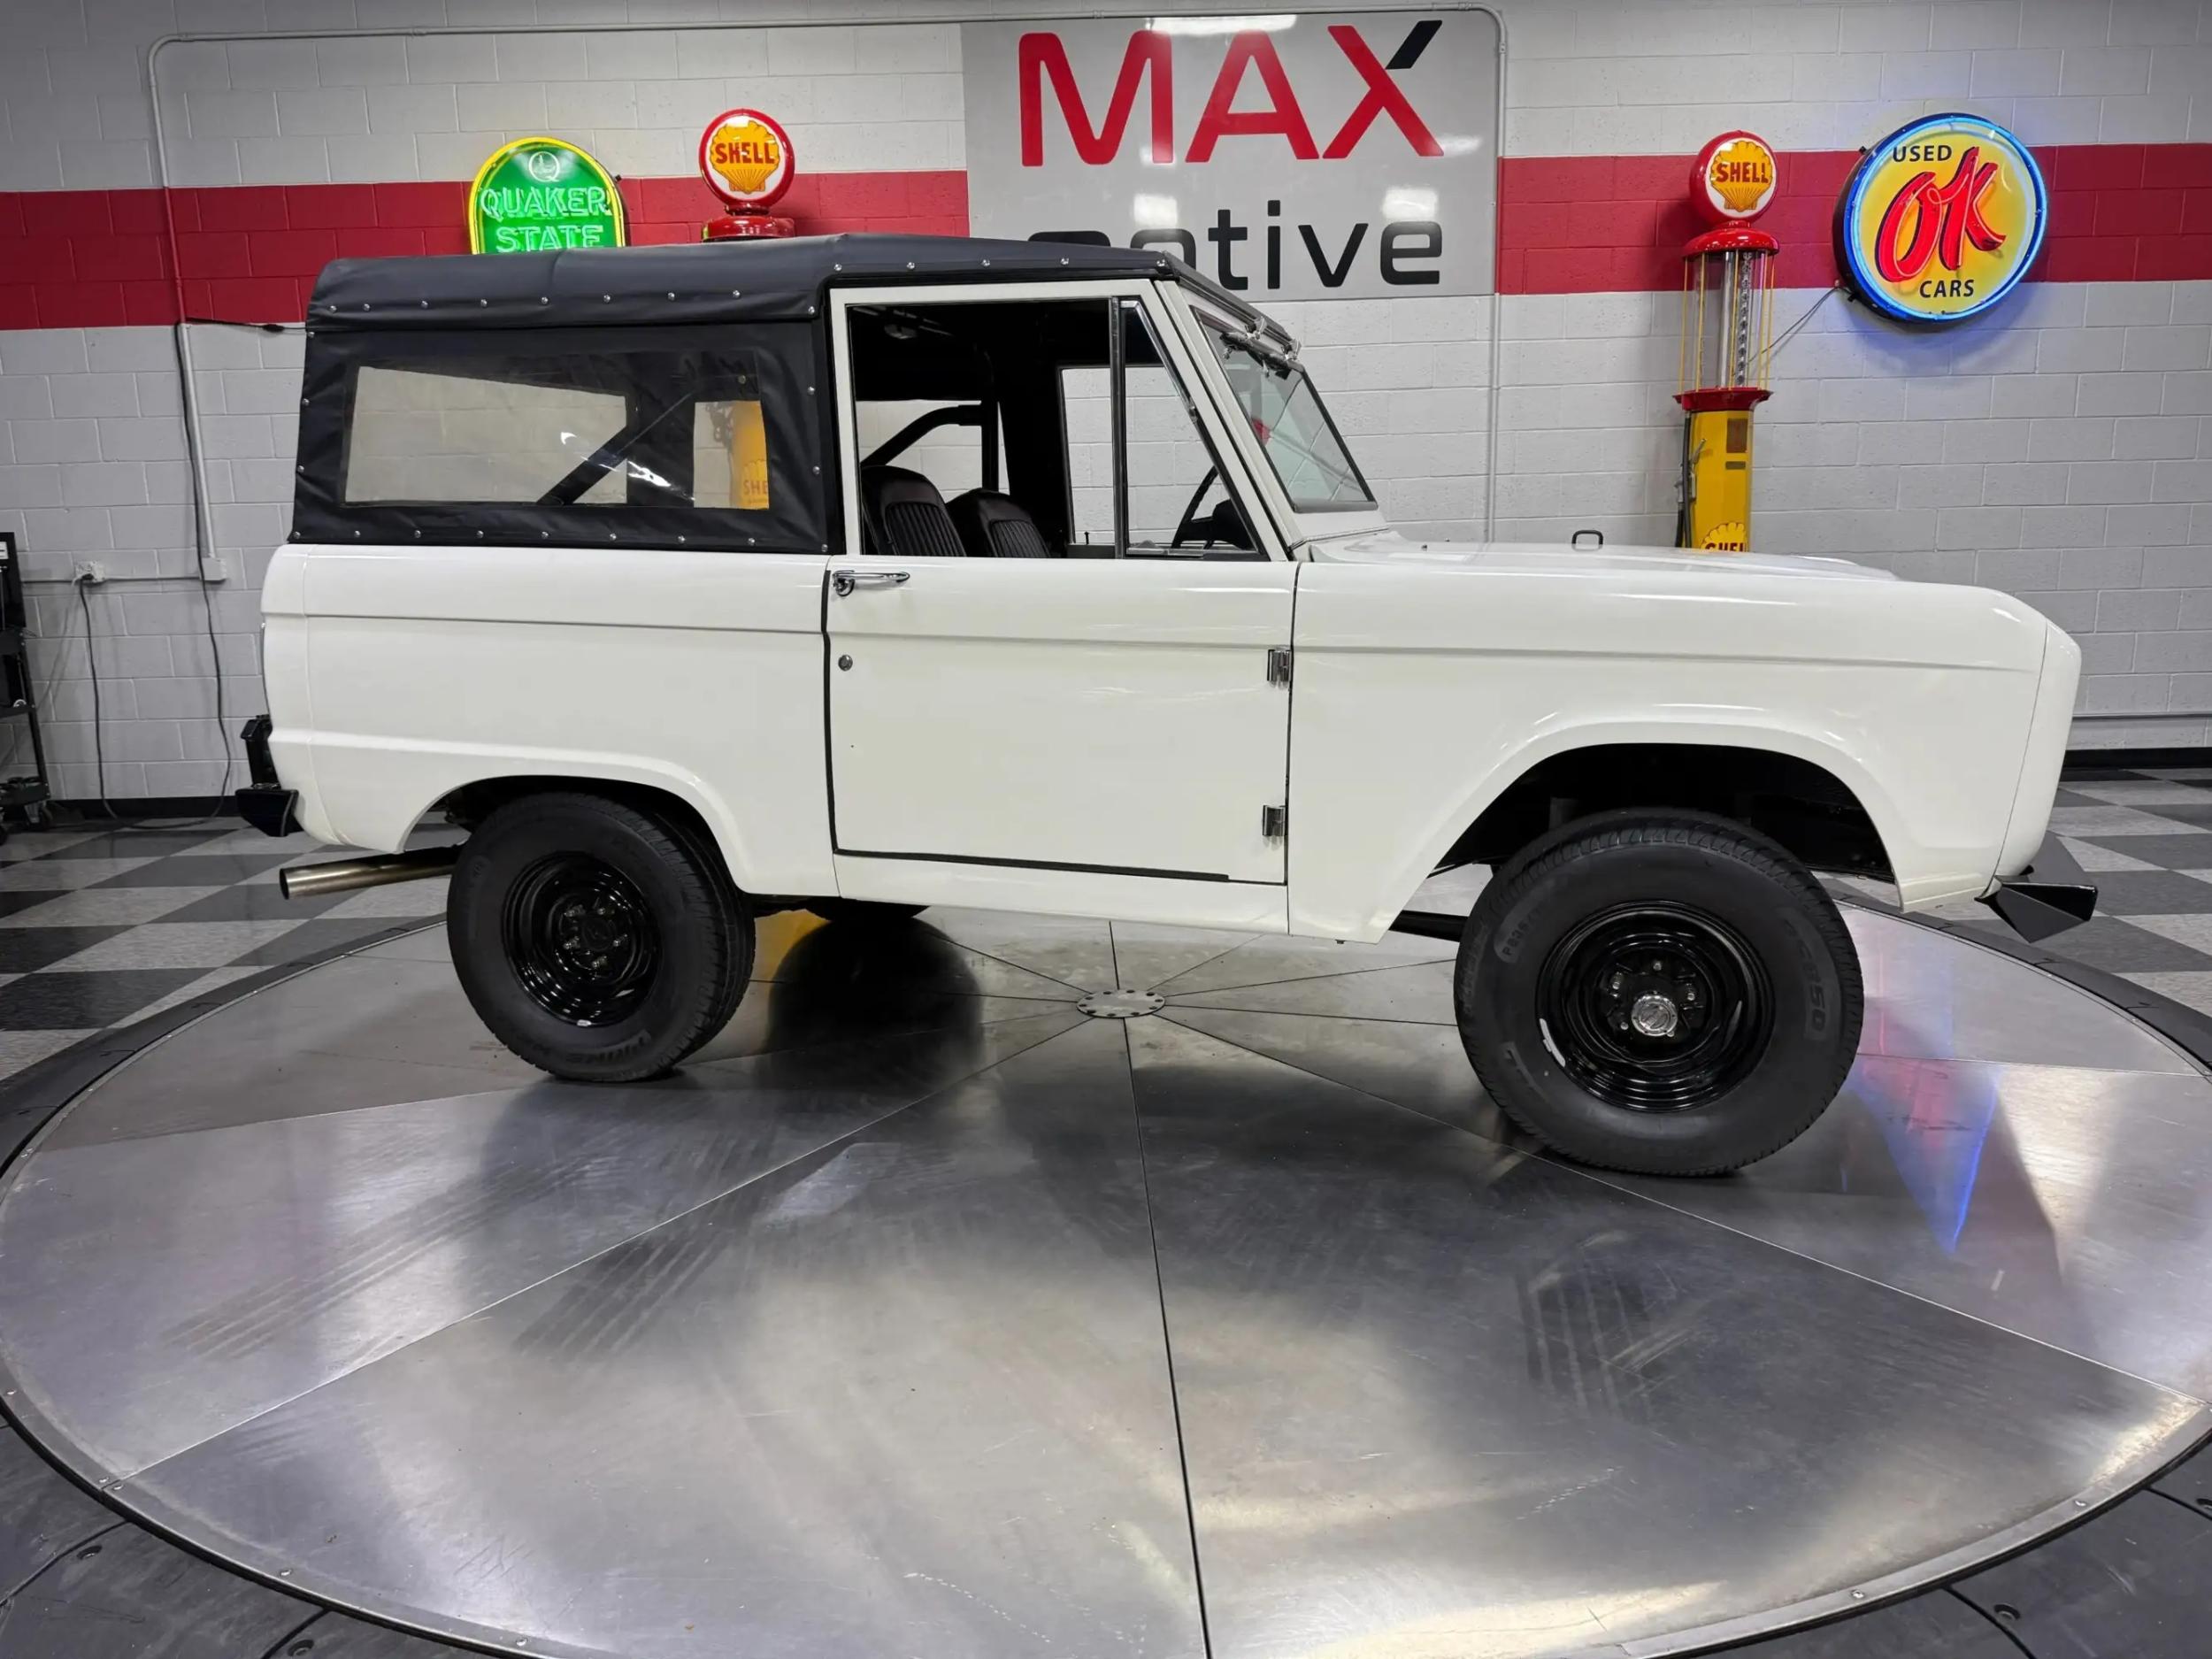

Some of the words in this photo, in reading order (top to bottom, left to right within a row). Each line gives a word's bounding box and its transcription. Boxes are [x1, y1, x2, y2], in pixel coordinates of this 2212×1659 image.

[1018, 19, 1445, 167] MAX
[714, 142, 775, 165] SHELL
[1892, 144, 1953, 163] USED
[1715, 161, 1770, 184] SHELL
[480, 186, 613, 222] QUAKER
[1874, 146, 2008, 283] OK
[495, 224, 604, 254] STATE
[1918, 279, 1975, 298] CARS
